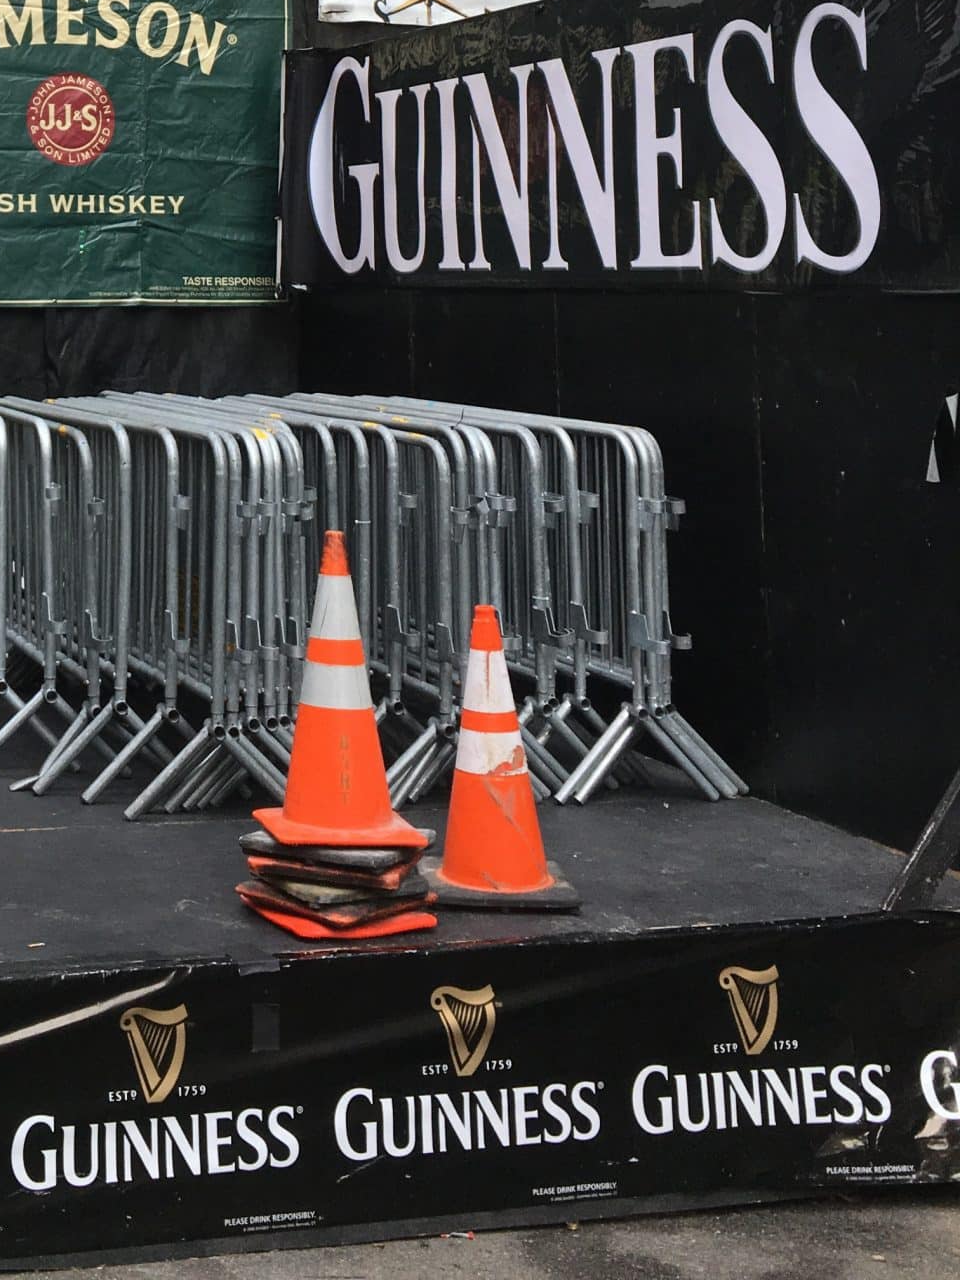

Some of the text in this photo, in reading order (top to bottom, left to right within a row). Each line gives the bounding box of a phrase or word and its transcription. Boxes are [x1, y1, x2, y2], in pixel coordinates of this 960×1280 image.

[30, 75, 111, 114] JOHN JAMESON
[40, 104, 97, 131] JJ&S
[37, 138, 63, 160] SON
[69, 128, 111, 163] LIMITED
[308, 2, 882, 275] GUINNESS
[49, 194, 185, 215] WHISKEY
[182, 276, 213, 285] TASTE
[773, 1039, 799, 1051] 1759
[484, 1058, 512, 1071] 1759
[177, 1084, 207, 1098] 1759
[632, 1063, 891, 1135] GUINNESS
[334, 1081, 601, 1162] GUINNESS
[10, 1105, 300, 1191] GUINNESS
[826, 1166, 851, 1175] PLEASE
[532, 1186, 555, 1196] PLEASE
[556, 1185, 576, 1194] DRINK
[224, 1216, 248, 1226] PLEASE
[250, 1215, 271, 1224] DRINK
